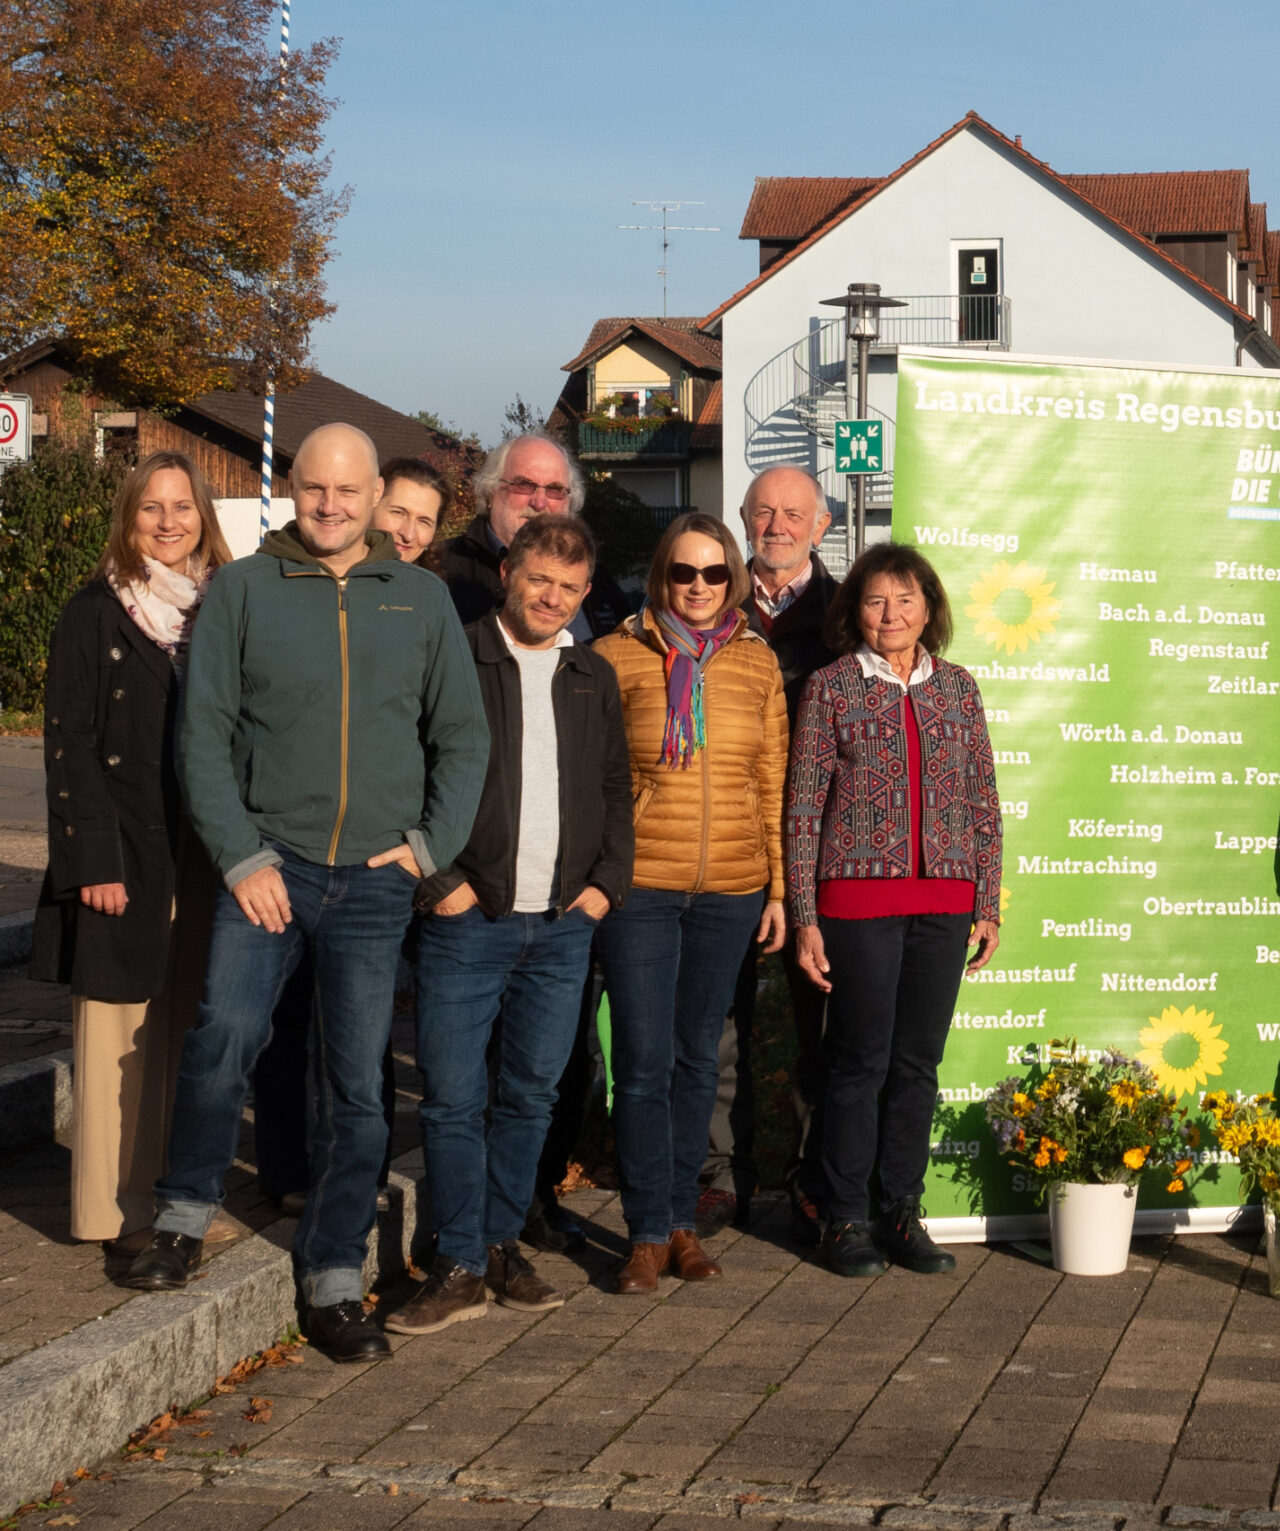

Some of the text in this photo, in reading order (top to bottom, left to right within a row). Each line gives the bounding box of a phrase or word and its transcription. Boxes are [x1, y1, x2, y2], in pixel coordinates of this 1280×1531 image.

[915, 380, 1105, 421] Landkreis
[0, 414, 11, 433] 0
[1, 446, 14, 457] NE
[1230, 478, 1272, 503] DIE
[914, 526, 1019, 553] Wolfsegg
[1079, 562, 1157, 583] Hemau
[1099, 602, 1266, 626] Bach a.d. Donau
[1149, 638, 1270, 662] Regenstauf
[964, 660, 1110, 683] rnhardswald
[1059, 723, 1243, 745] Wörth a.d. Donau
[1110, 765, 1216, 785] Holzheim
[1221, 771, 1239, 785] a.
[1068, 819, 1163, 843] Köfering
[1017, 856, 1157, 879] Mintraching
[1041, 918, 1132, 942] Pentling
[961, 963, 1077, 984] onaustauf
[1101, 972, 1219, 992] Nittendorf
[950, 1008, 1047, 1029] ttendorf
